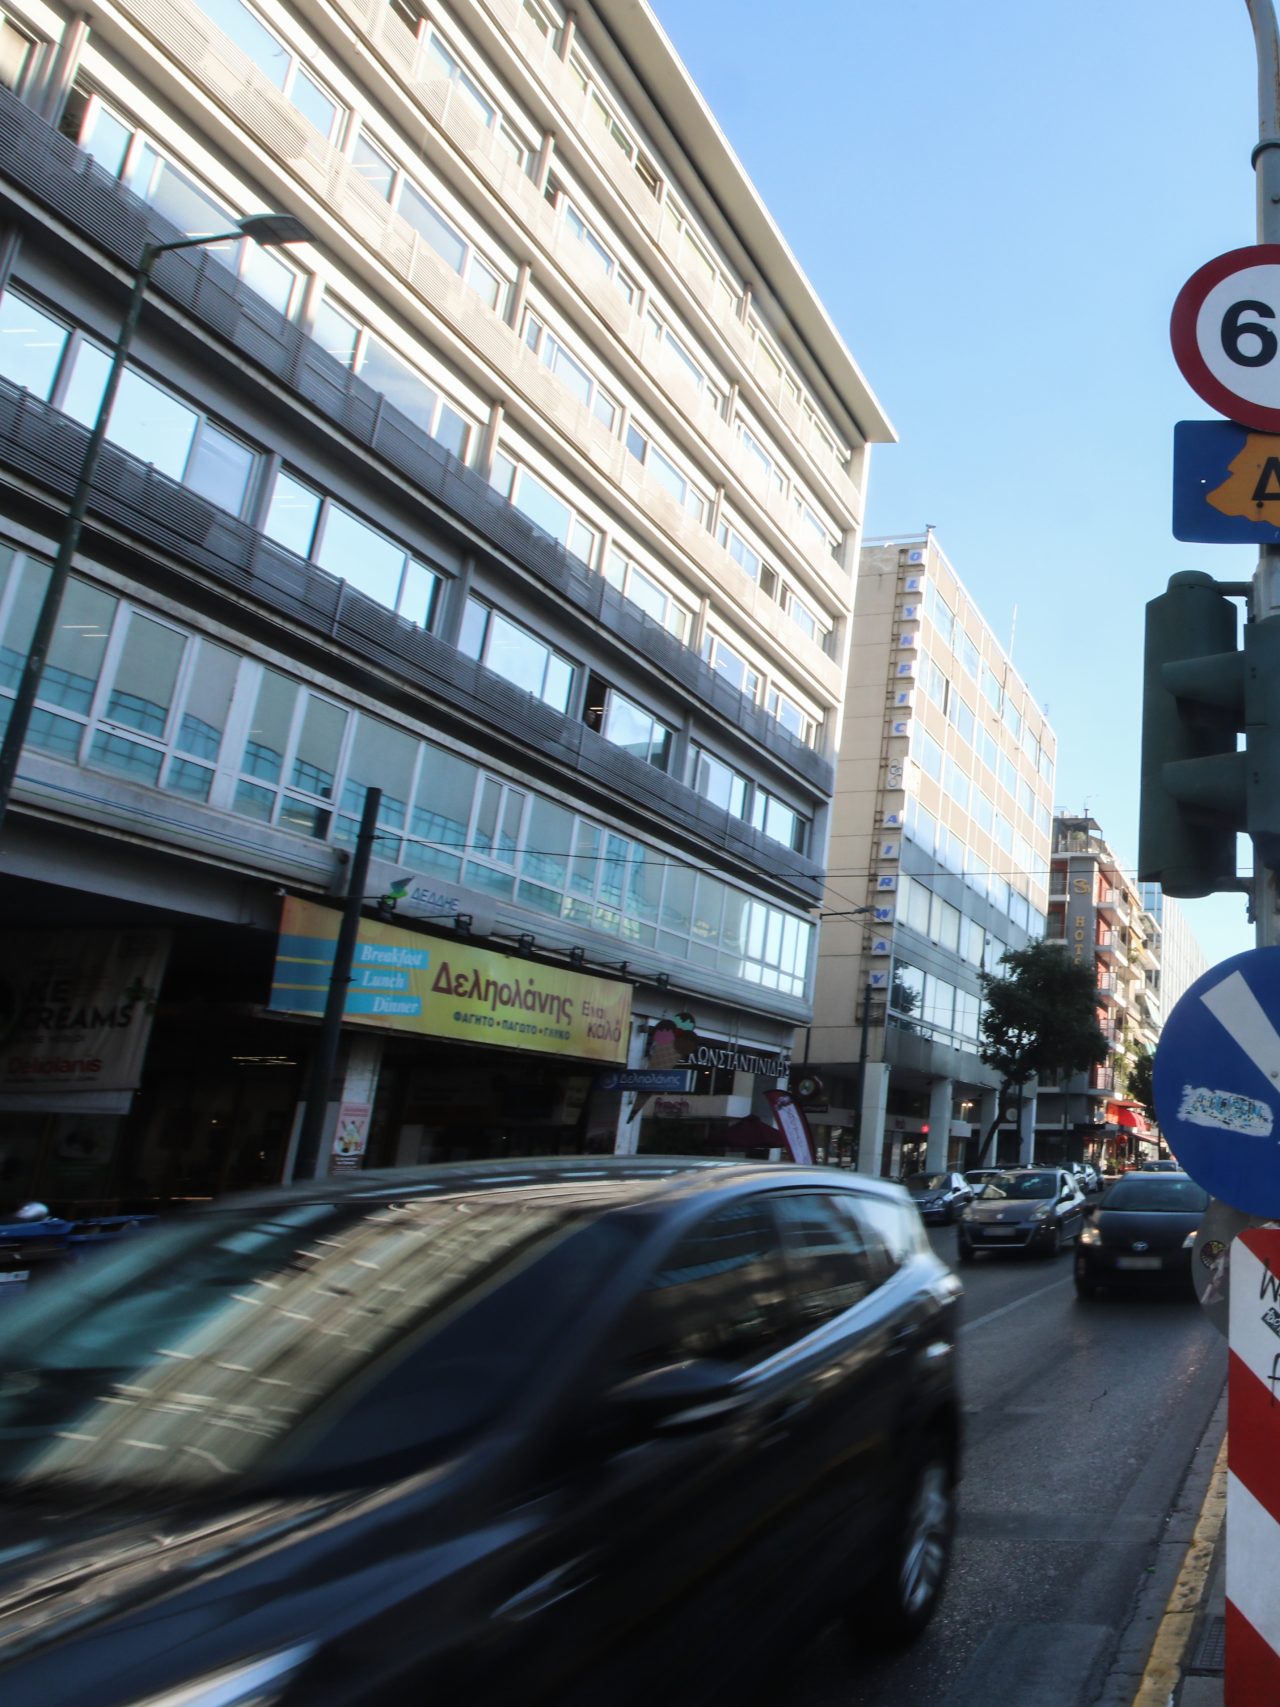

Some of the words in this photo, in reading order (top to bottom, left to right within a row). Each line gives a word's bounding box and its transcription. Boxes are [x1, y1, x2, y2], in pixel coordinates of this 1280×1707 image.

[360, 945, 423, 967] Breakfast
[362, 971, 405, 988] Lunch
[431, 961, 574, 1026] Δεληολάνης
[372, 996, 419, 1014] Dinner
